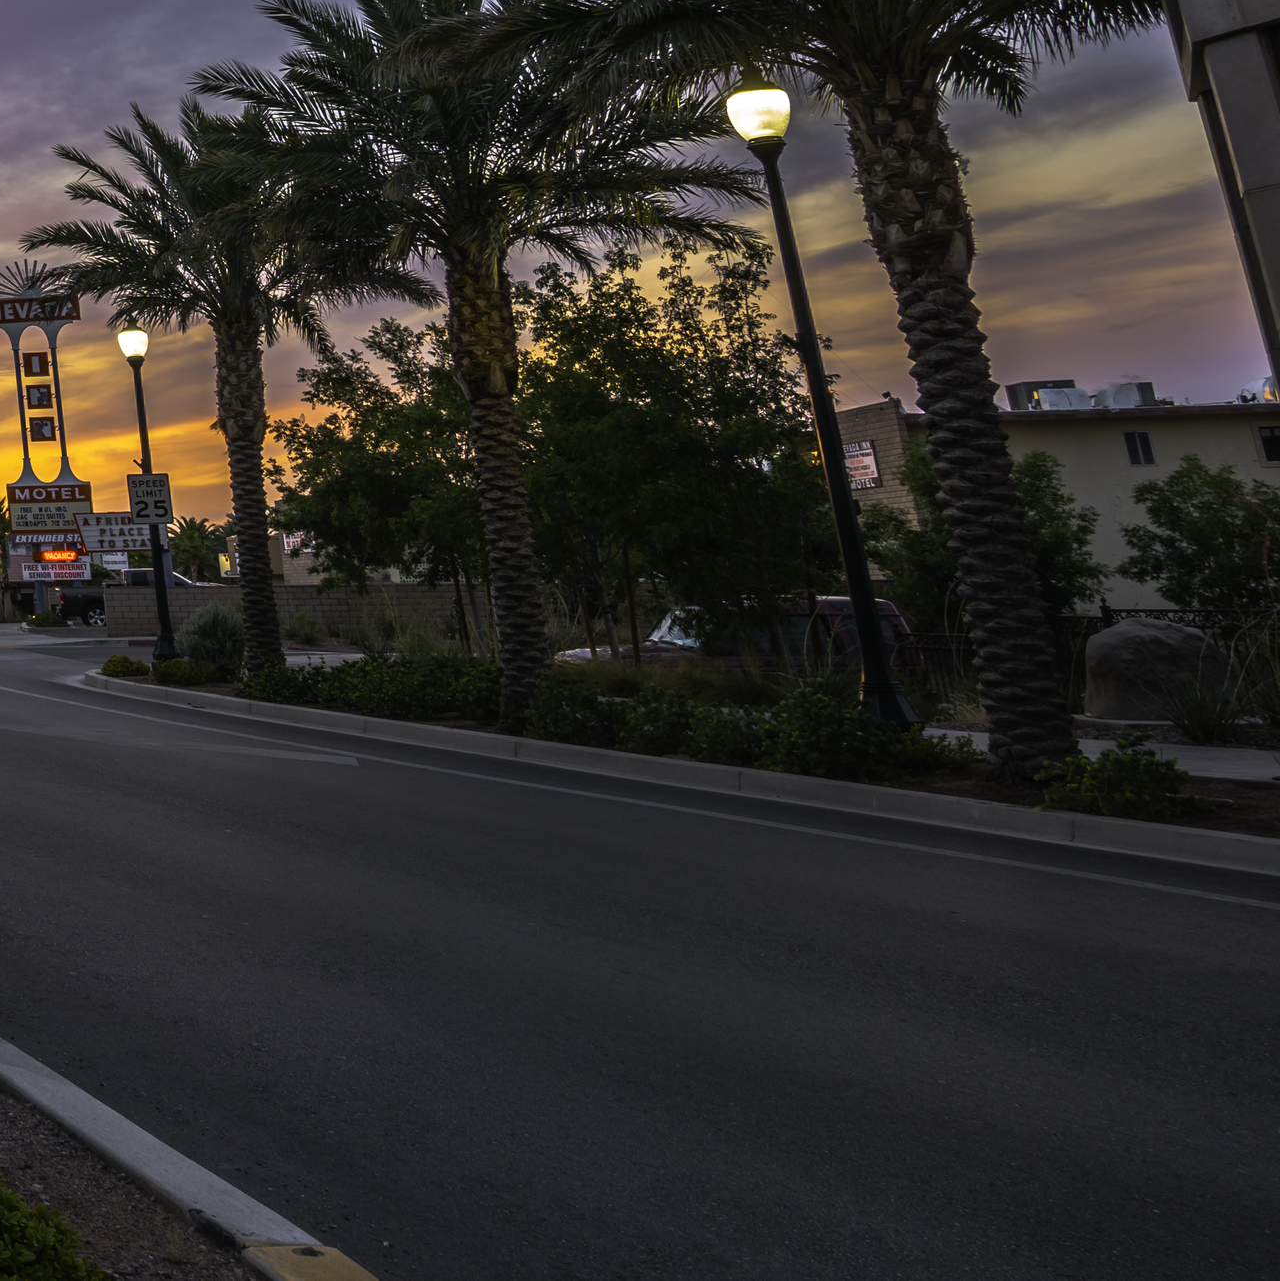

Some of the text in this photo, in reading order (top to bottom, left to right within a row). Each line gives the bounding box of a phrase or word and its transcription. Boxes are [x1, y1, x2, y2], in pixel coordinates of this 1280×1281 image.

[843, 443, 860, 452] EVADA
[131, 479, 166, 488] SPEED
[15, 487, 86, 500] MOTEL
[135, 489, 163, 498] LIMIT
[134, 500, 169, 519] 25
[82, 517, 90, 526] A
[99, 527, 144, 537] PLACE
[15, 534, 64, 543] EXTENDED
[98, 539, 116, 548] TO
[44, 552, 75, 560] VACANCY
[23, 564, 39, 572] FREE
[58, 563, 87, 571] INTERNET
[53, 571, 85, 579] DISCOUNT
